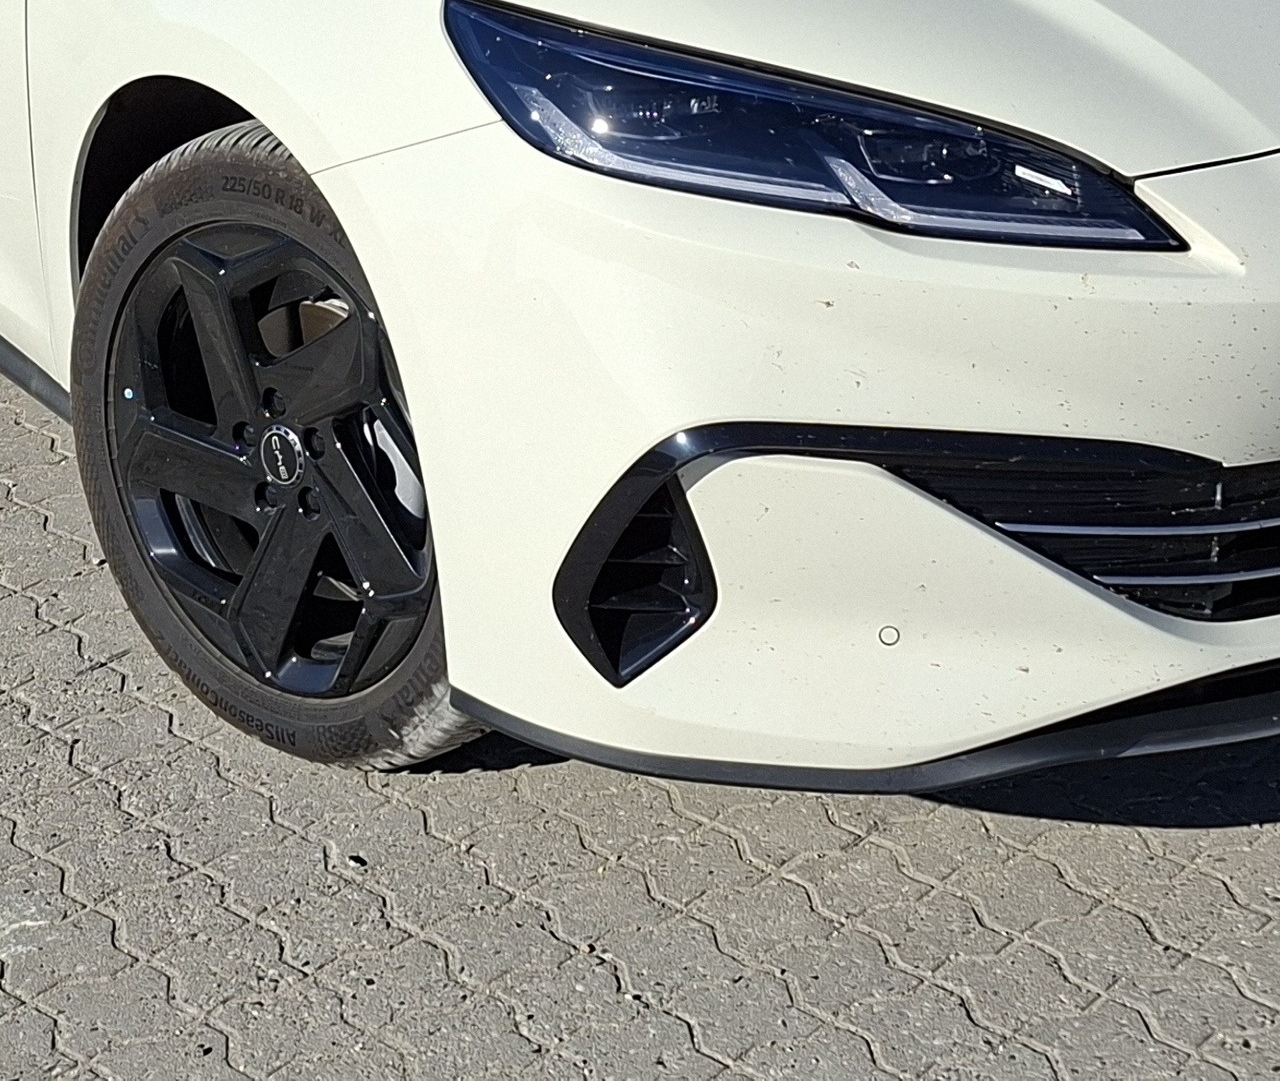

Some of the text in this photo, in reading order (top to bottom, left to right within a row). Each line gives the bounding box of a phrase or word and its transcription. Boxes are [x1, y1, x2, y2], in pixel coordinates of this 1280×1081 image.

[221, 175, 270, 201] 225/50
[274, 189, 286, 207] R
[289, 194, 304, 215] 18
